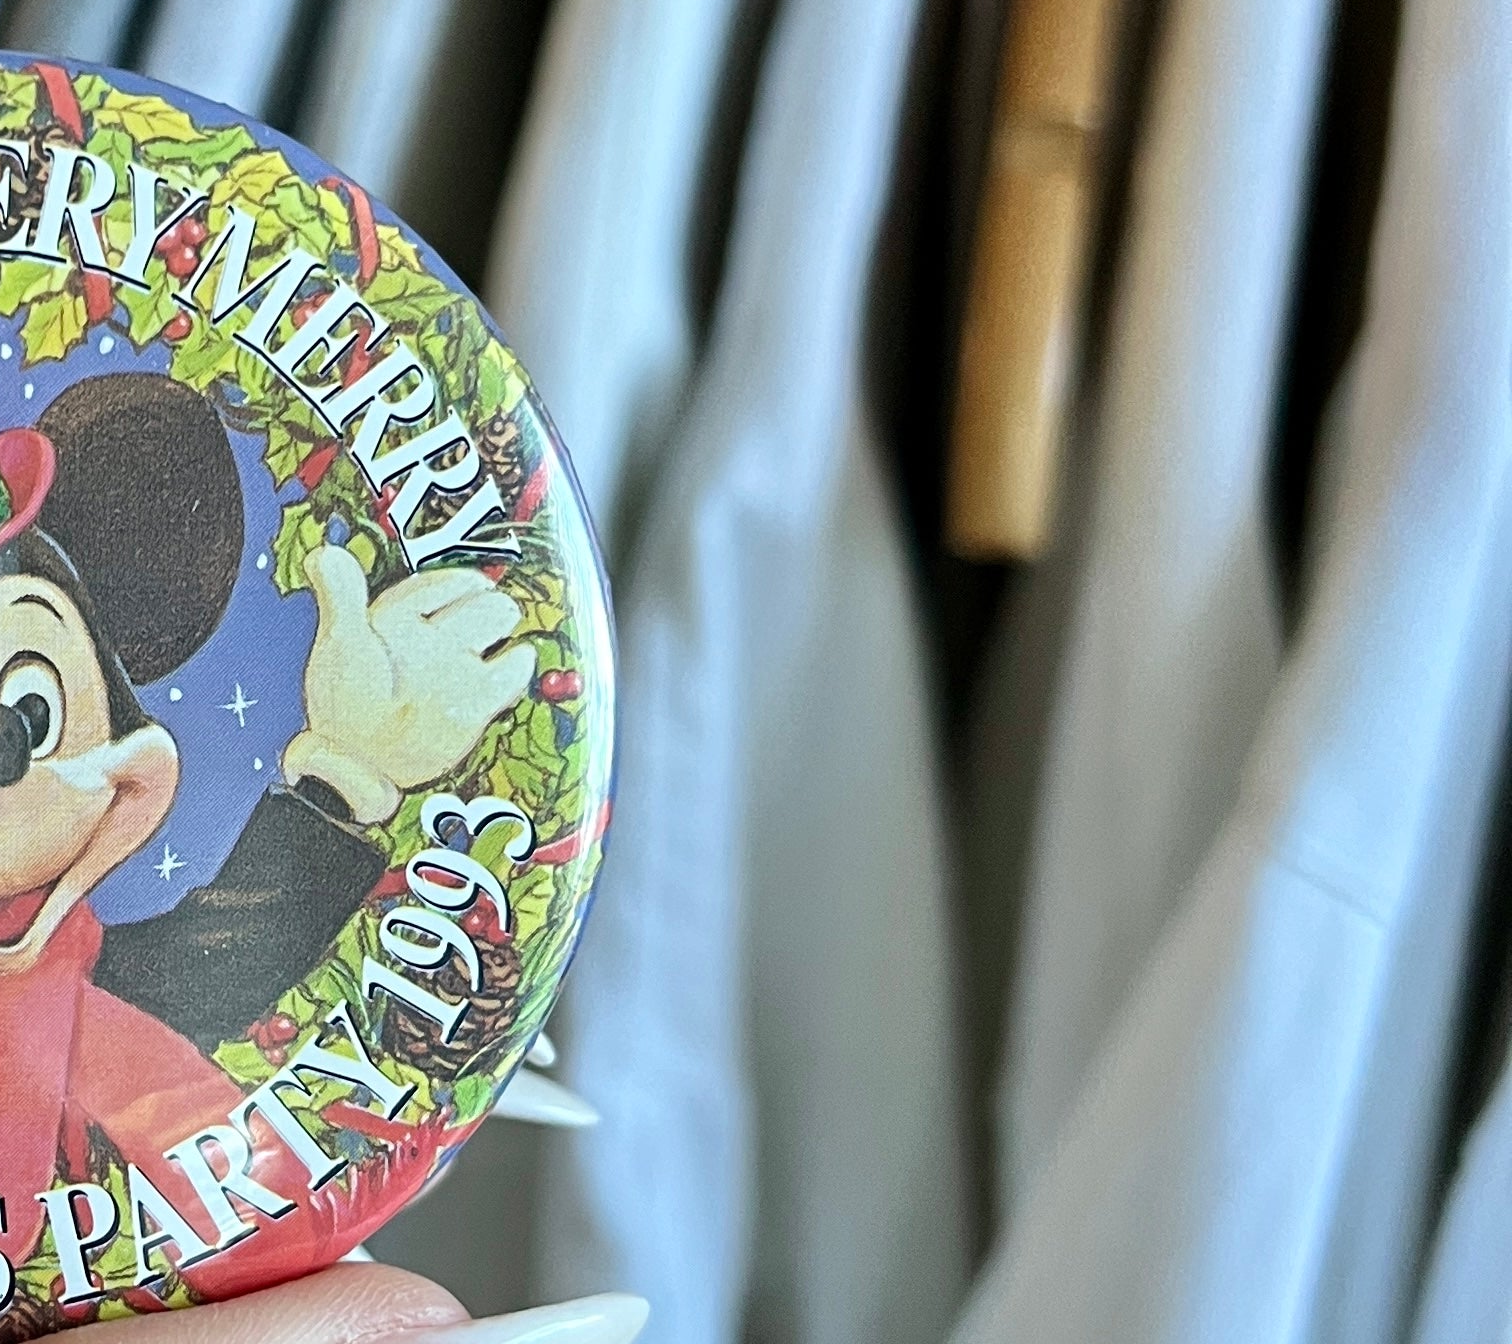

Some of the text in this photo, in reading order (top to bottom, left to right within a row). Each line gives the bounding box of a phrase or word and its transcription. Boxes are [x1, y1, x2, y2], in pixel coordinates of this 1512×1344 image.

[170, 204, 525, 574] MERRY
[34, 999, 419, 1306] PARTY
[362, 792, 538, 1045] 1993
